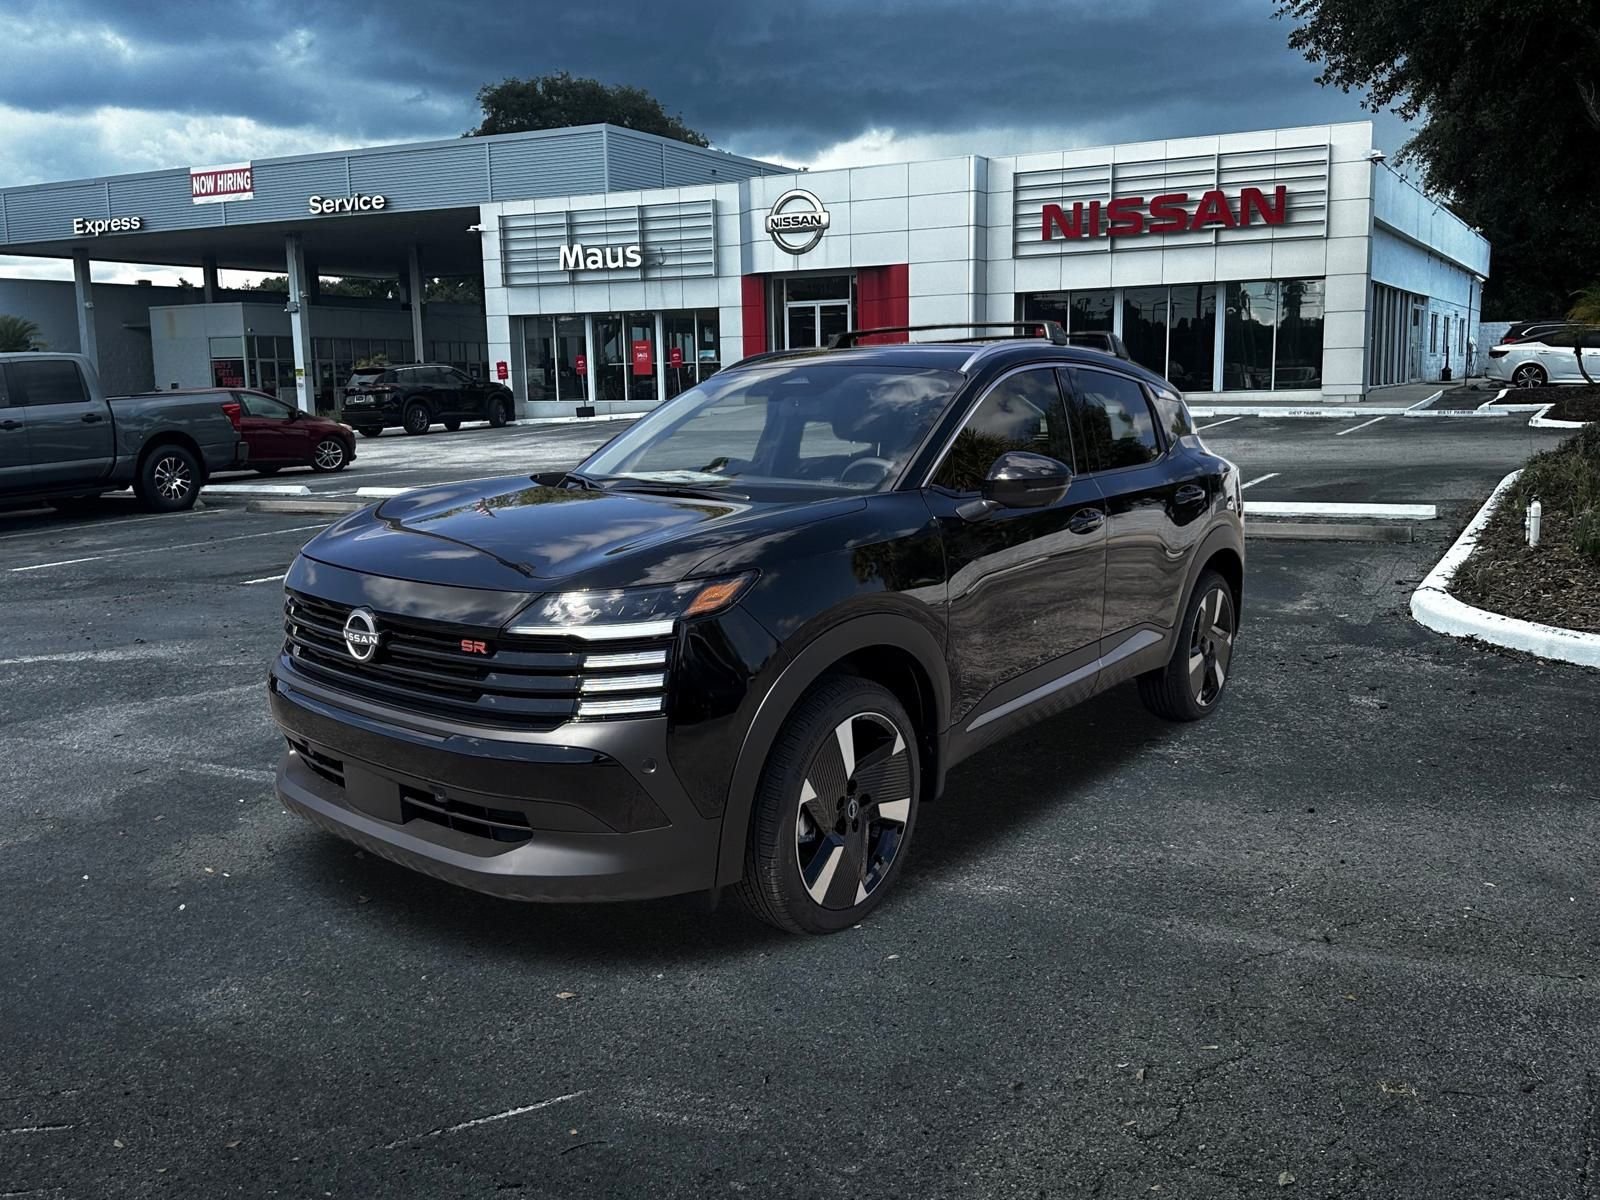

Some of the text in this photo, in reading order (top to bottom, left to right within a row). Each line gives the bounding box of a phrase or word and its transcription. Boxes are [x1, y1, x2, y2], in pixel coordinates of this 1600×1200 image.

[193, 171, 251, 195] NOW HIRING
[309, 193, 385, 215] Service
[1042, 185, 1287, 241] NISSAN
[73, 216, 141, 237] Express
[770, 214, 822, 228] NISSAN
[560, 243, 642, 271] Maus
[461, 639, 487, 655] SR
